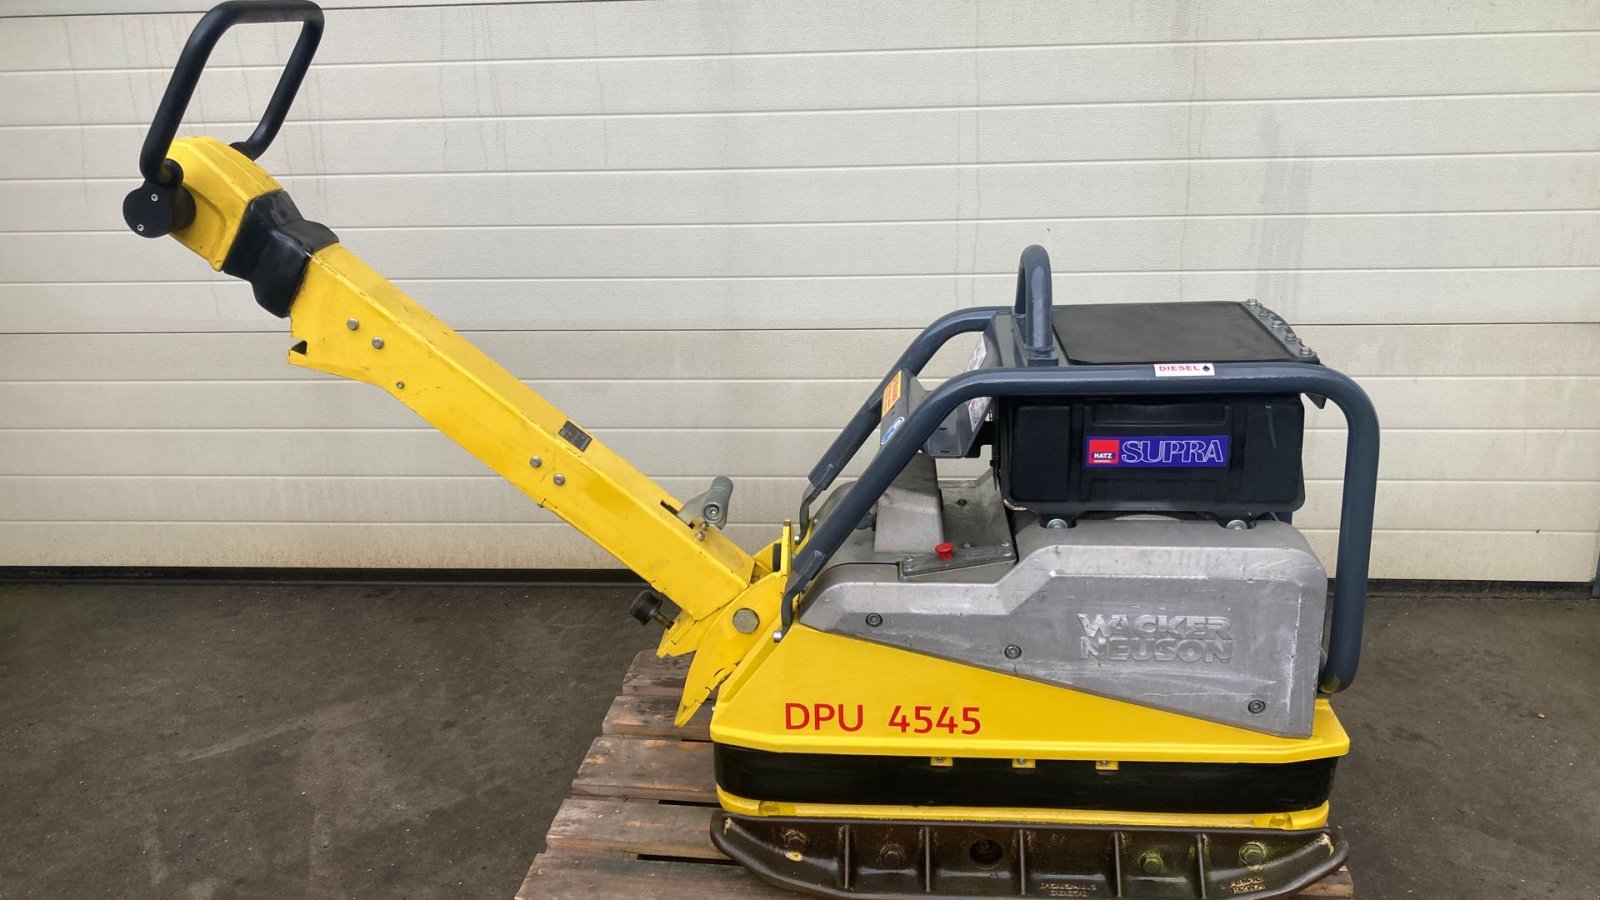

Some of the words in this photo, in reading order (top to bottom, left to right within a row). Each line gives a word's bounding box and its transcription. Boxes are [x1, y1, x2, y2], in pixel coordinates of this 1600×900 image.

[1121, 440, 1224, 463] SUPRA
[1077, 613, 1232, 638] WACKER
[1080, 637, 1233, 663] NEUSON
[785, 703, 864, 732] DPU
[888, 705, 981, 735] 4545
